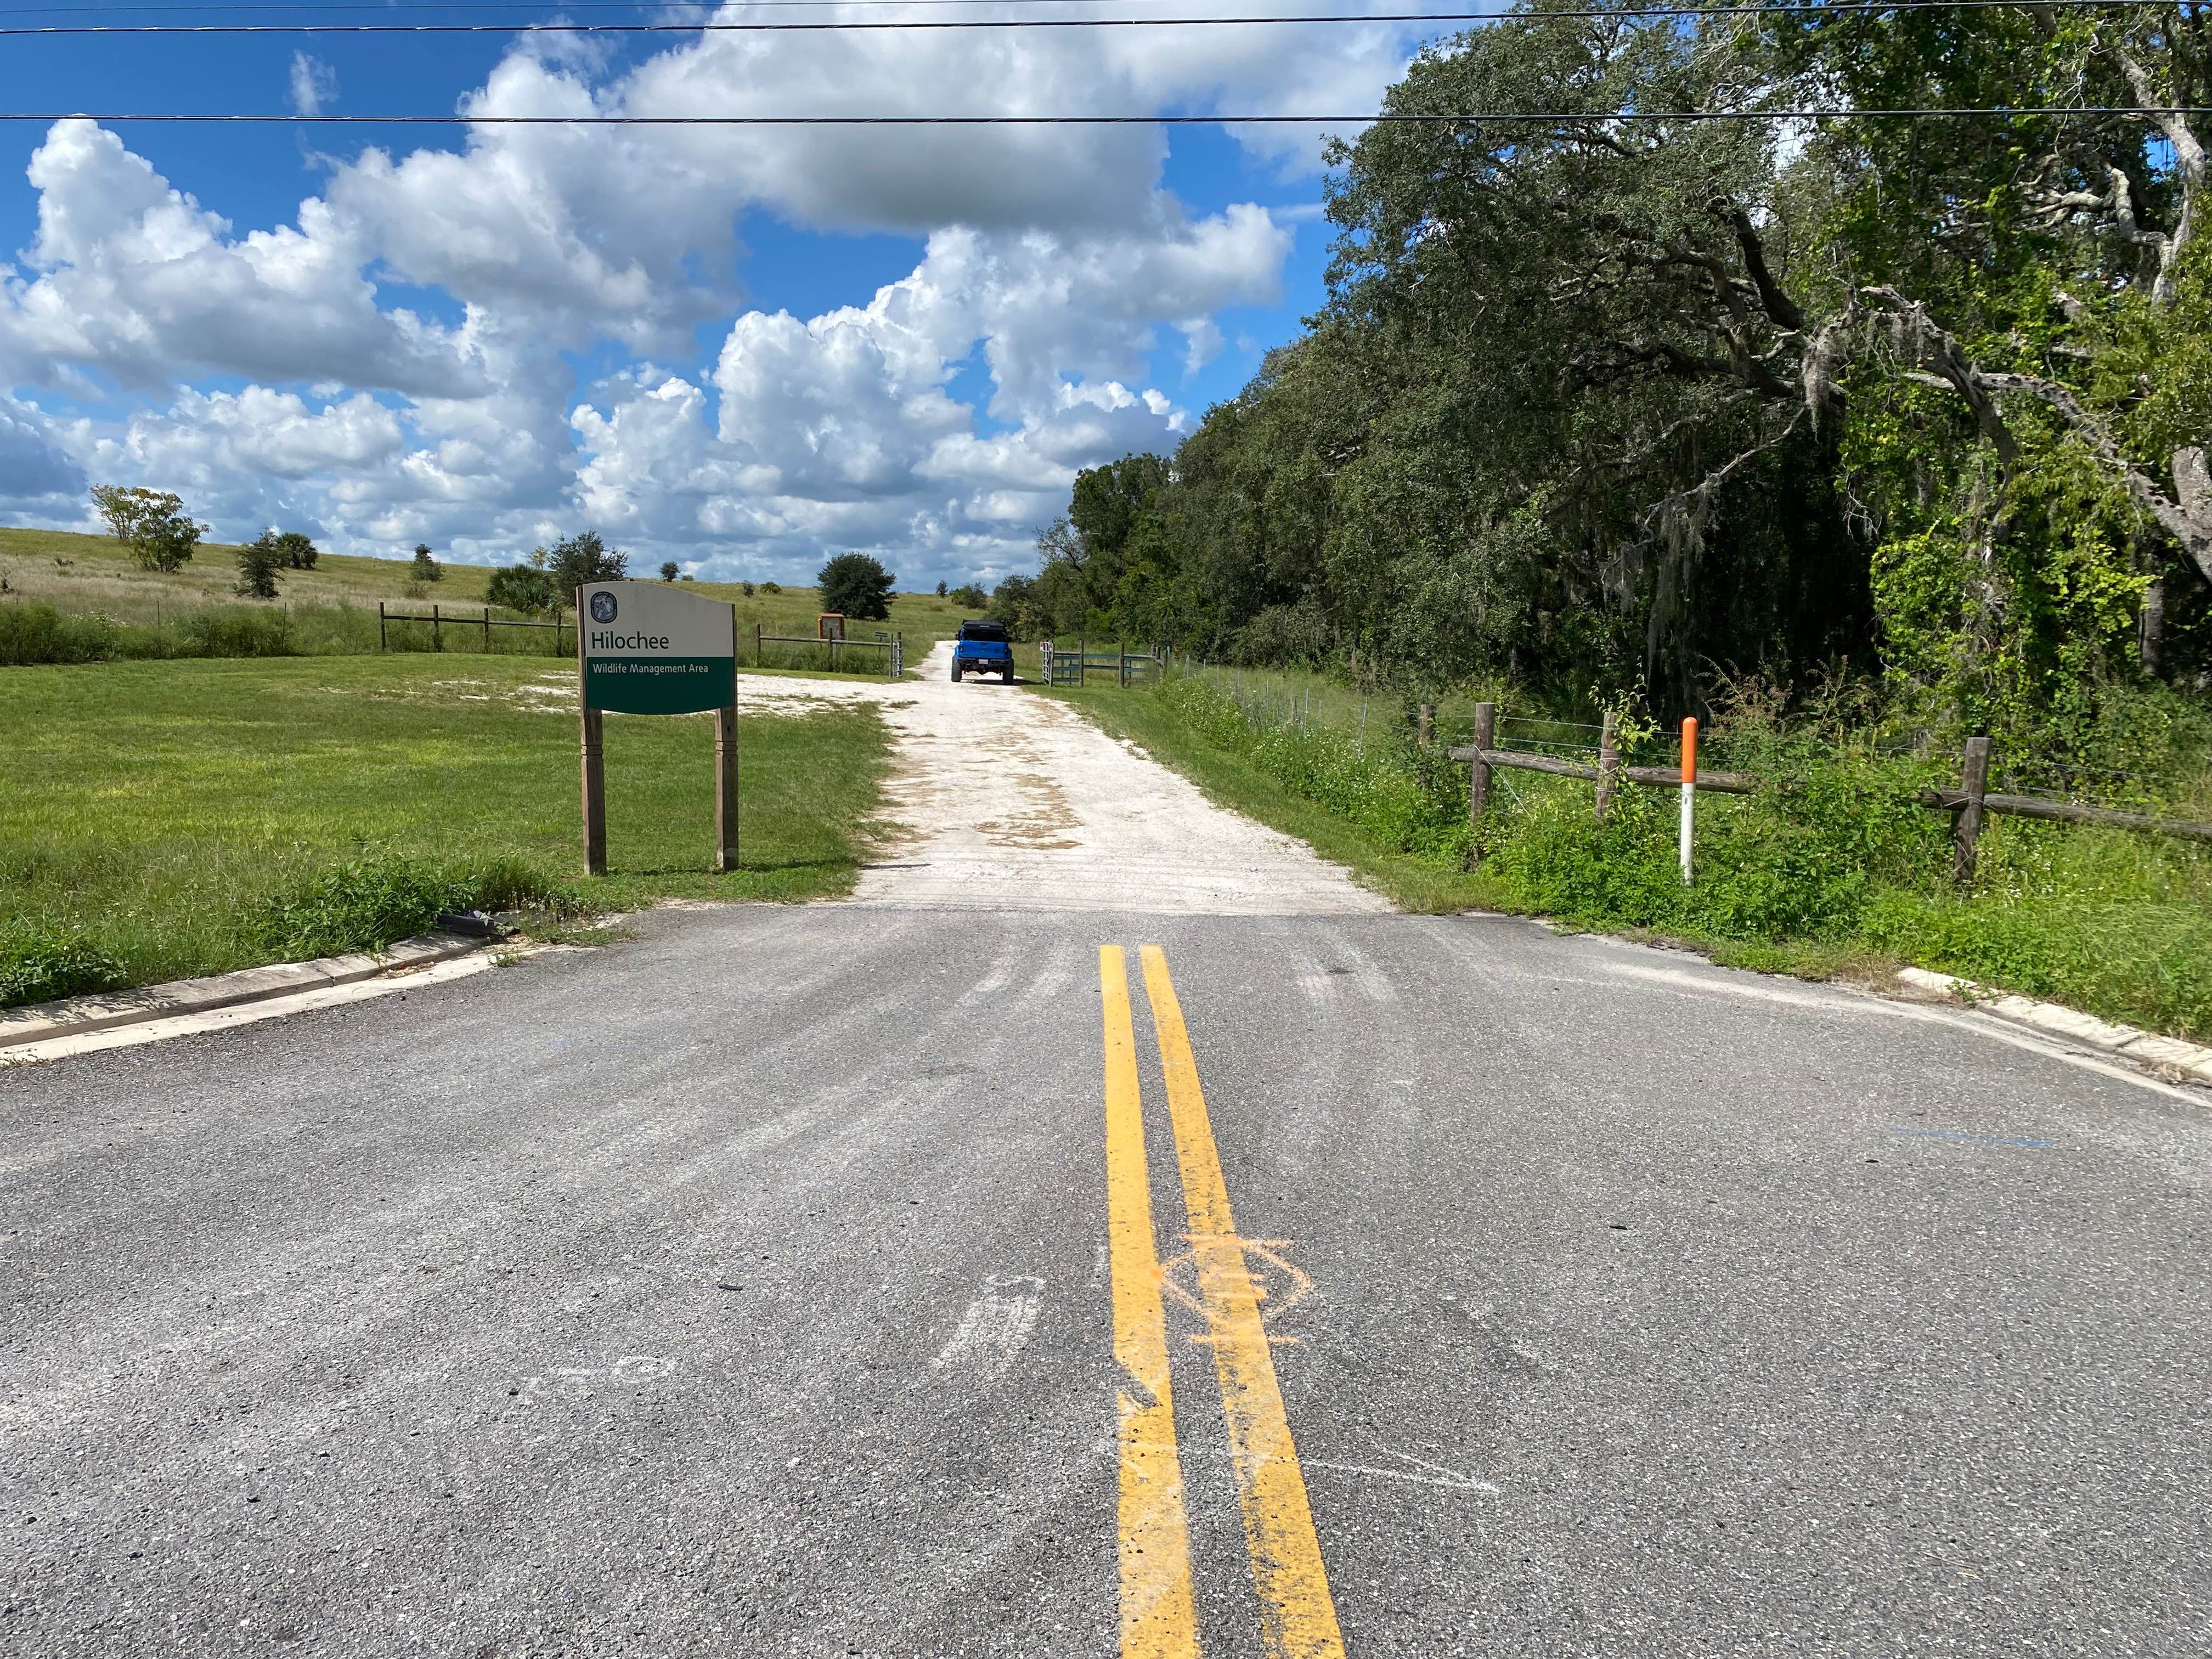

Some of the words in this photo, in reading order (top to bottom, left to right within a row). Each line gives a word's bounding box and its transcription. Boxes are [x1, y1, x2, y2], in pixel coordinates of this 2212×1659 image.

[591, 631, 669, 650] Hilochee
[592, 663, 627, 673] Wildlife
[629, 664, 686, 675] Management
[689, 664, 708, 673] Area
